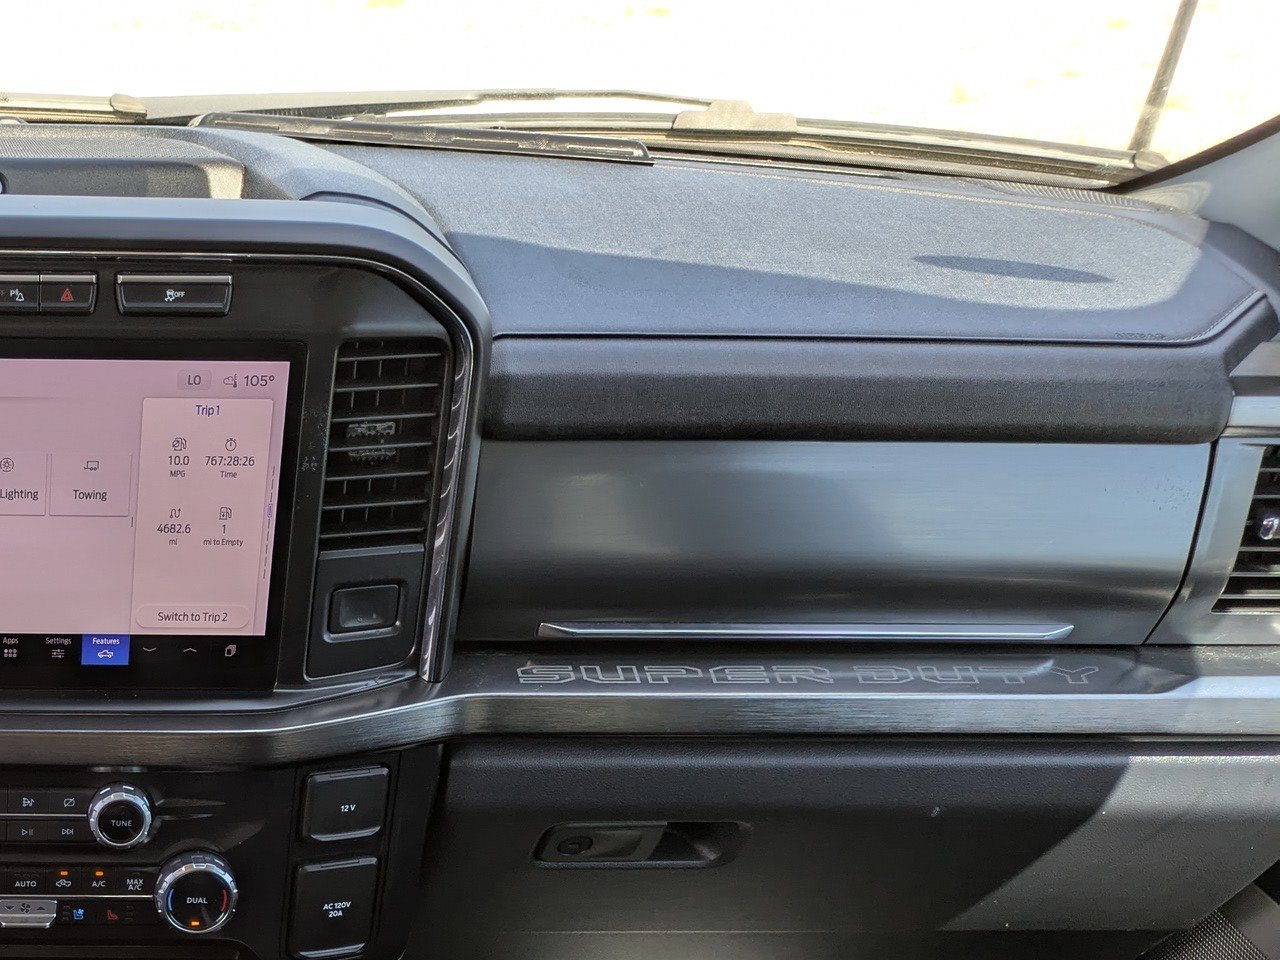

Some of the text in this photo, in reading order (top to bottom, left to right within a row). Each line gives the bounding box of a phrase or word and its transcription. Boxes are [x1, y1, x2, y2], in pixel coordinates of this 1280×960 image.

[187, 375, 202, 385] LO
[244, 375, 275, 386] 105°
[195, 405, 220, 417] Trip 1
[168, 455, 190, 466] 10.0
[205, 455, 255, 467] 767:28:26
[169, 470, 186, 478] MPG
[220, 470, 238, 479] Time
[0, 488, 39, 501] Lighting
[72, 489, 107, 502] Towing
[156, 523, 191, 534] 4682.6
[221, 524, 226, 534] 1
[169, 538, 178, 546] mi
[203, 538, 244, 547] mi to Empty
[157, 611, 228, 623] Switch to Trip 2
[2, 637, 18, 645] Apps
[45, 637, 71, 645] Settings
[92, 637, 120, 645] Features
[517, 665, 1099, 685] SUPER DUTY
[340, 804, 349, 812] 12
[111, 820, 132, 828] TUNE
[15, 880, 37, 888] AUTO
[92, 880, 106, 888] A/C
[127, 884, 142, 892] A/C
[186, 896, 208, 904] DUAL
[323, 901, 352, 910] AC 120V
[328, 910, 343, 918] 20A
